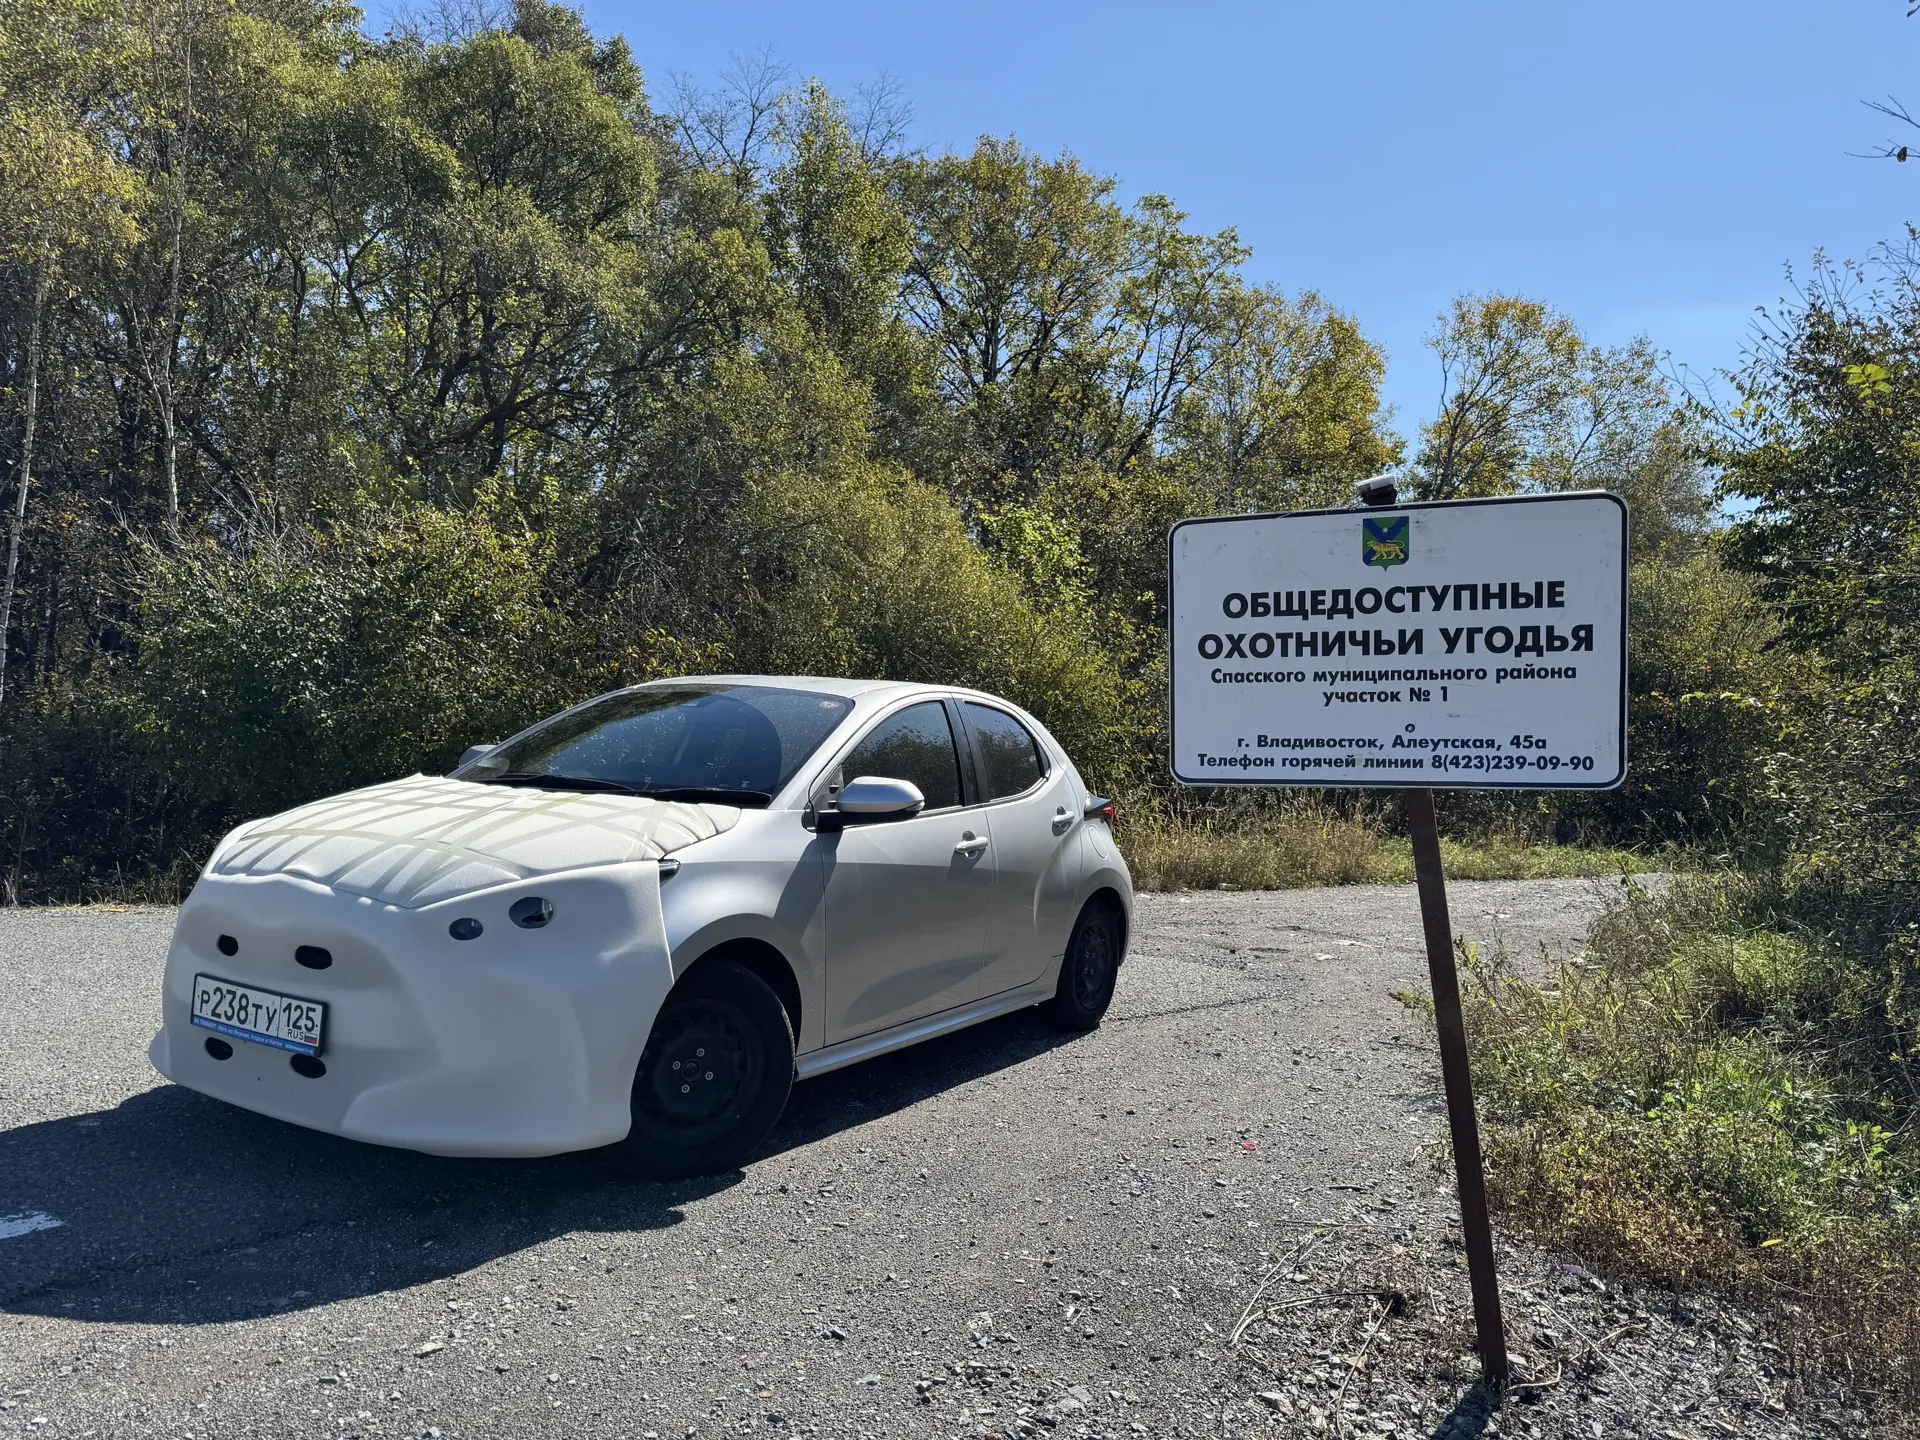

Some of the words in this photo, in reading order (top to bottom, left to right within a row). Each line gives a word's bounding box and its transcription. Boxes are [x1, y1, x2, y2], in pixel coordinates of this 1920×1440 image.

[1222, 580, 1565, 620] ОБЩЕДОСТУПНЫЕ
[1197, 628, 1424, 660] ОХОТНИЧЬИ
[1444, 624, 1594, 658] УГОДЬЯ
[1210, 668, 1306, 684] Спасского
[1312, 665, 1488, 685] муниципального
[1496, 663, 1577, 683] района
[1322, 690, 1402, 707] участок
[1409, 687, 1431, 703] №
[1440, 686, 1449, 702] 1
[1237, 737, 1250, 749] г.
[1257, 735, 1385, 751] Владивосток,
[1391, 735, 1503, 752] Алеутская,
[1509, 735, 1547, 750] 45а
[1197, 754, 1275, 770] Телефон
[1281, 755, 1356, 770] горячей
[1362, 757, 1424, 769] линии
[1430, 754, 1595, 773] 8(423)239-09-90
[282, 1002, 316, 1033] 125
[287, 1028, 304, 1041] RUS
